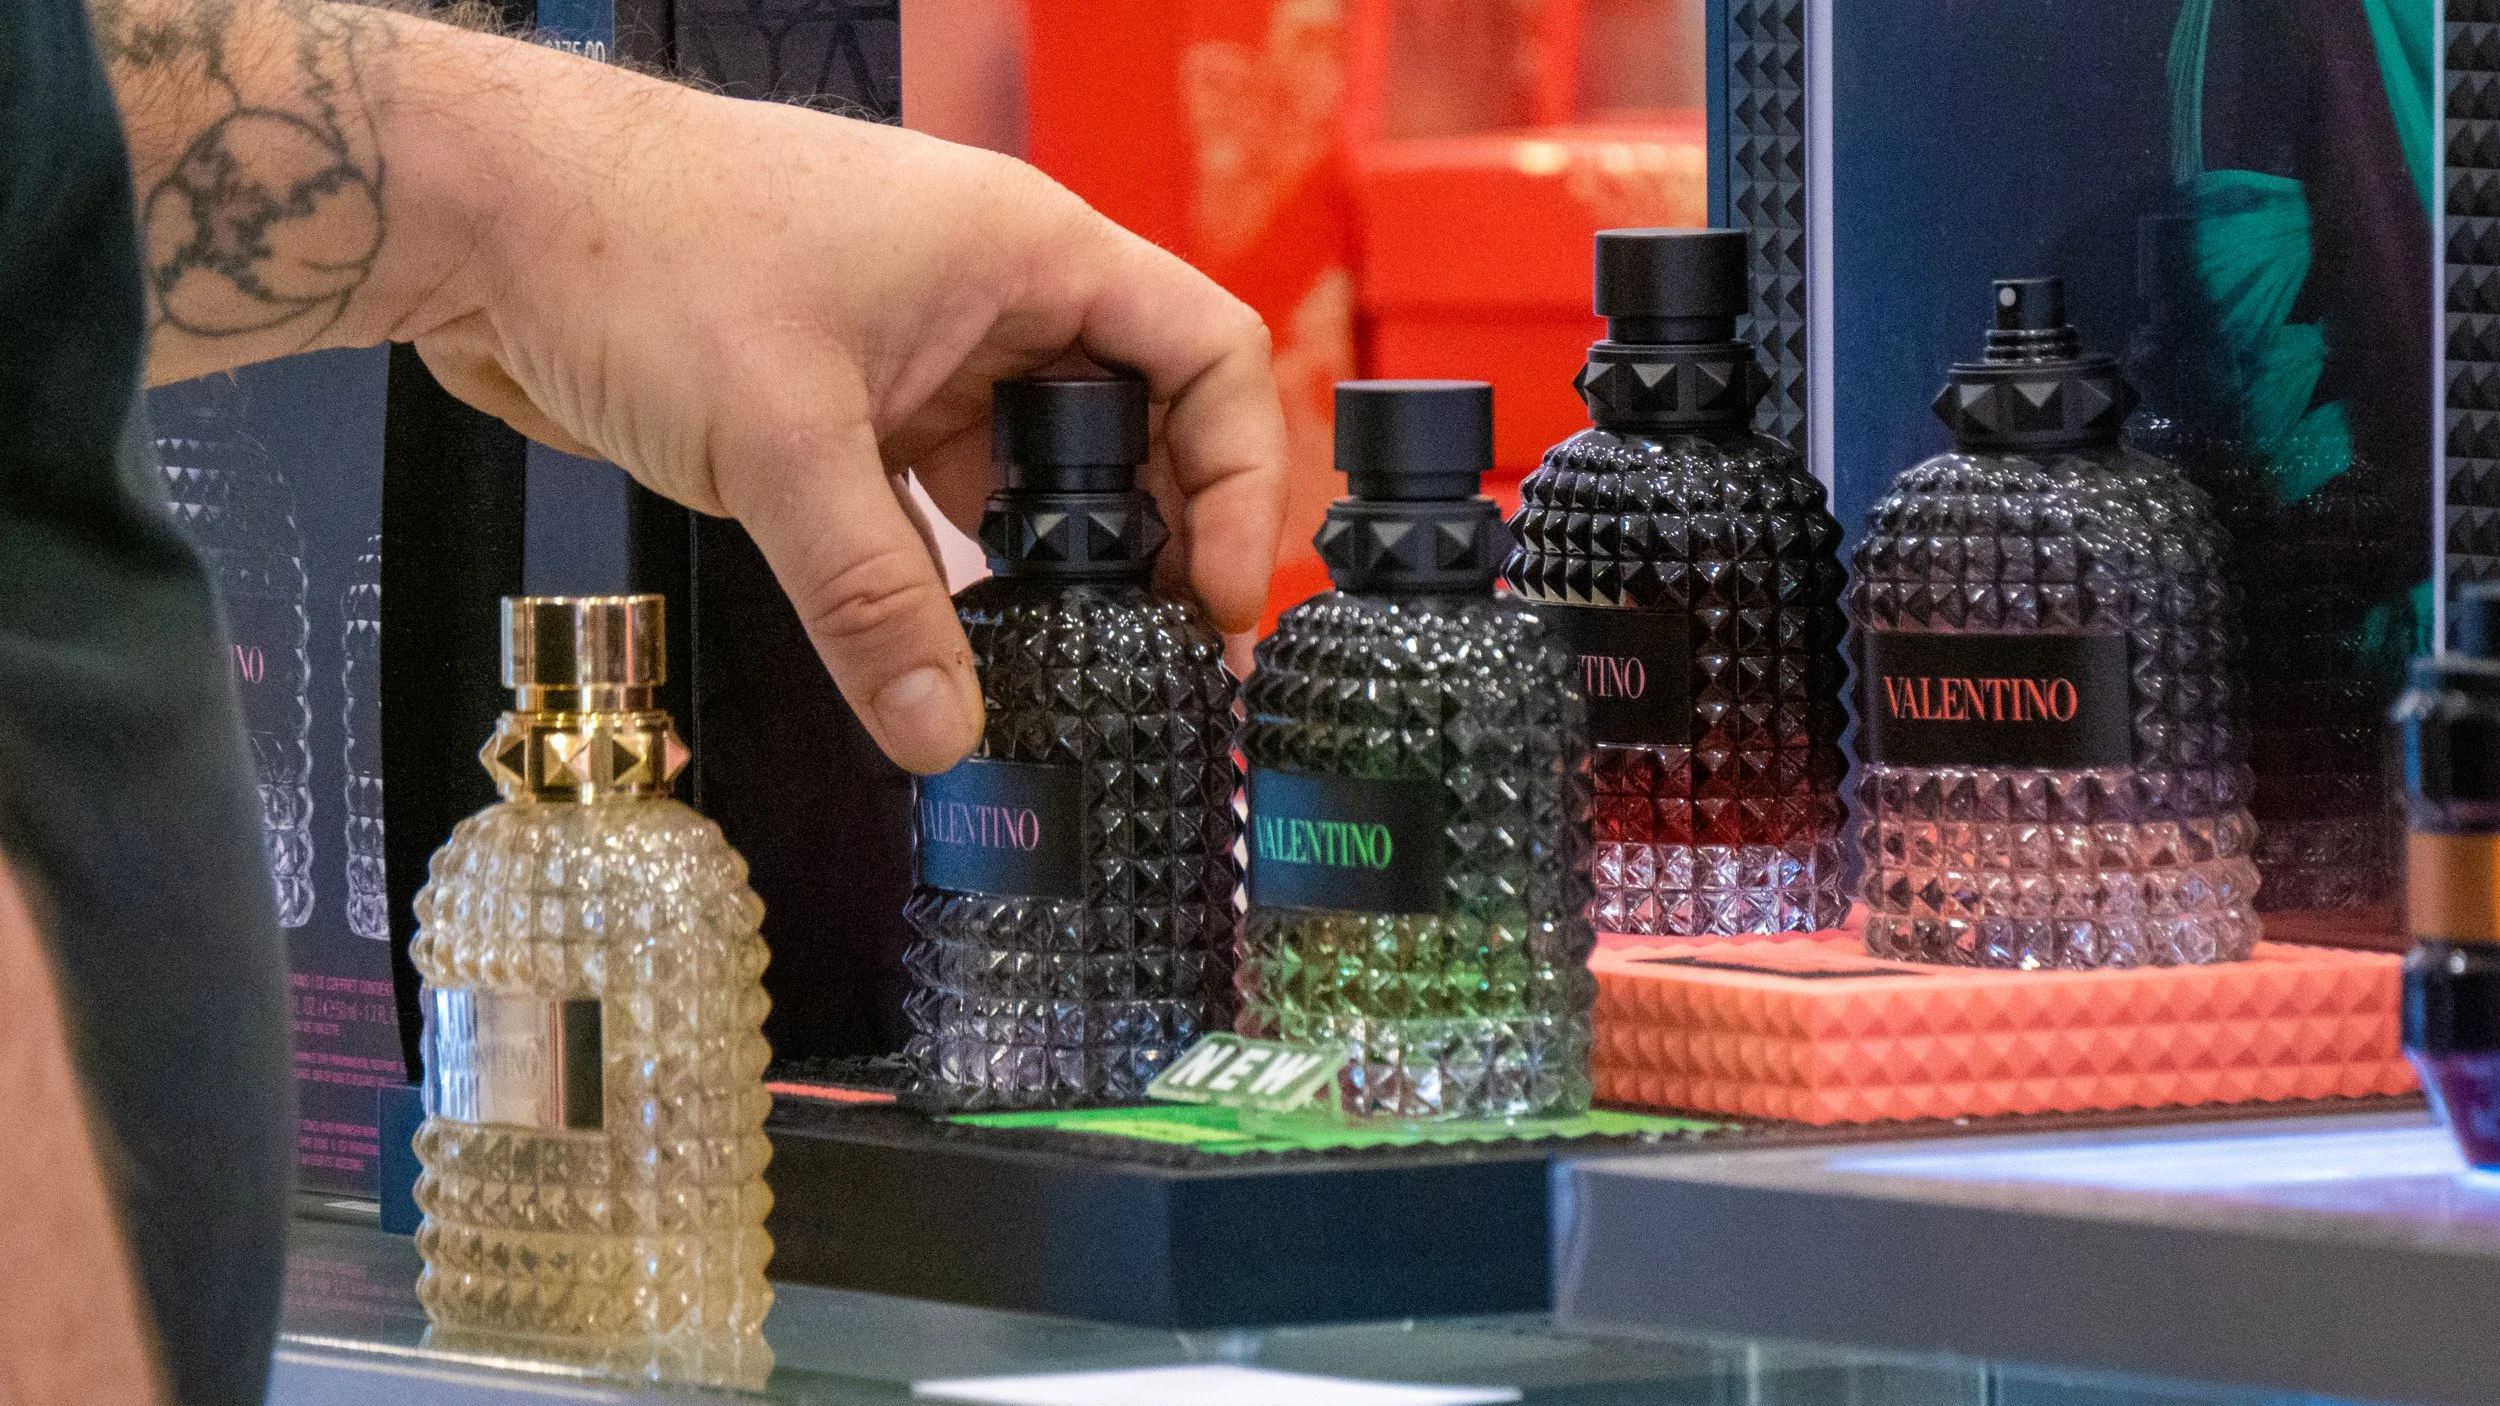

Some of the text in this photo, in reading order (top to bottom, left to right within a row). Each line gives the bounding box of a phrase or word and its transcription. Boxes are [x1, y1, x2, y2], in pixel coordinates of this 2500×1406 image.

[1579, 655, 1645, 699] TINO
[1884, 676, 2078, 722] VALENTINO
[1255, 814, 1392, 871] VALENTINO
[1168, 1043, 1322, 1096] NEW
